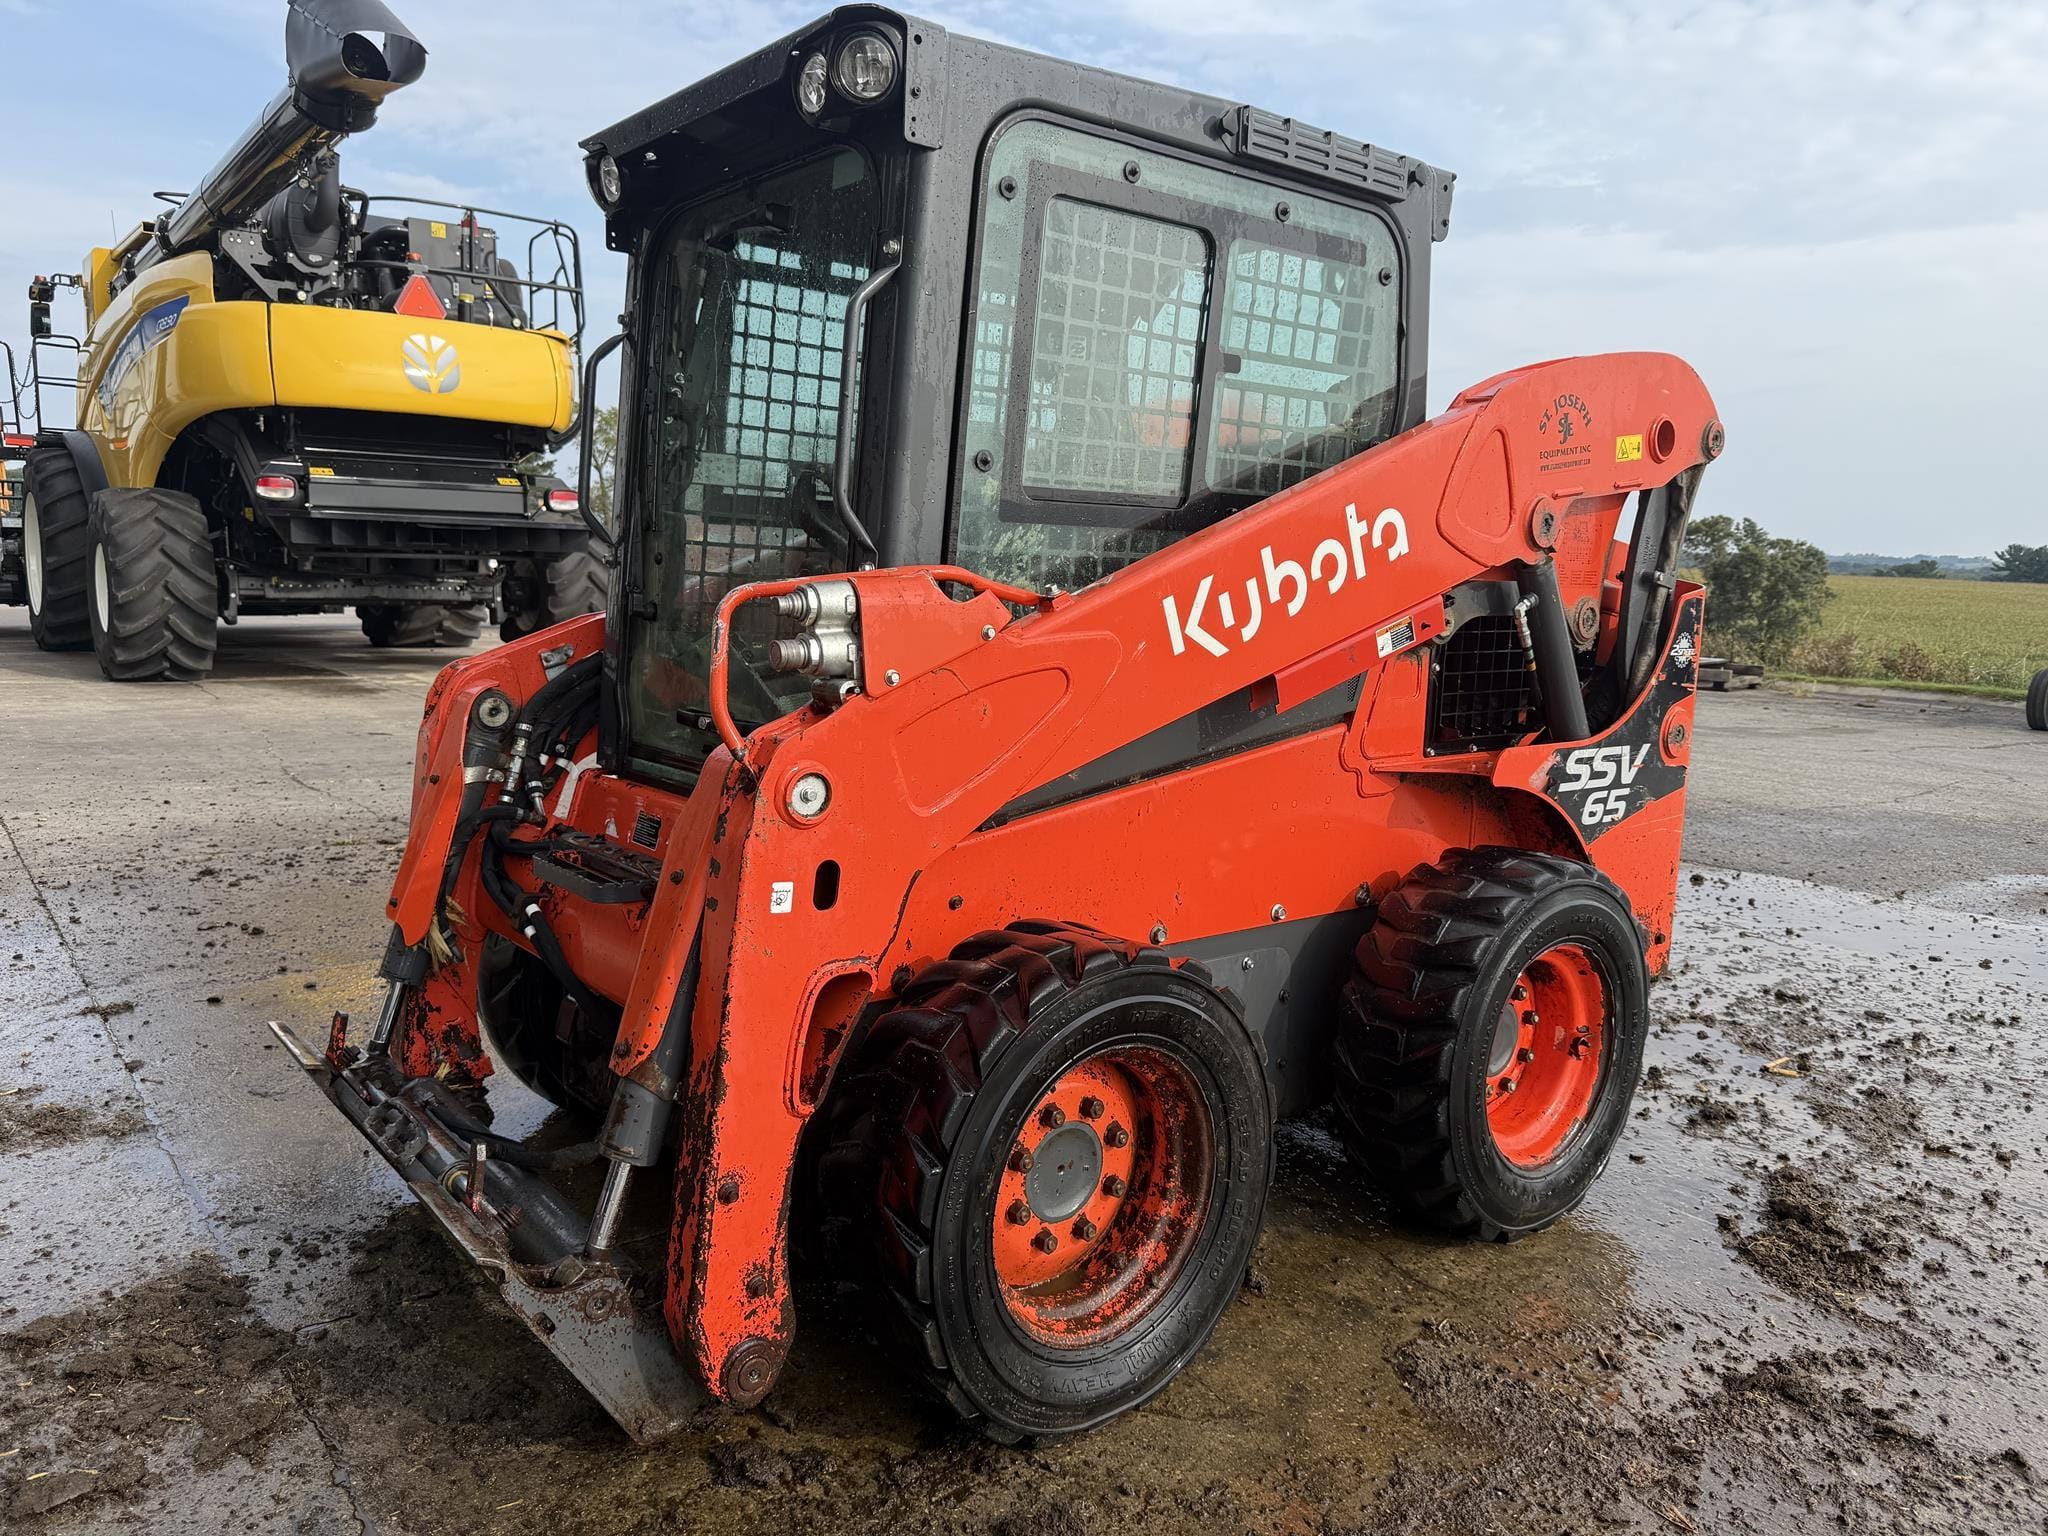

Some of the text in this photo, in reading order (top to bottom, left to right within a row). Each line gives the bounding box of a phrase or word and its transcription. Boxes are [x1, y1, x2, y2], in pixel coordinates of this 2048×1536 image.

[1539, 393, 1593, 434] ST. JOSEPH
[1539, 444, 1592, 460] EQUIPMENT INC
[1162, 502, 1409, 658] Kubota
[1558, 743, 1651, 792] SSV
[1581, 787, 1630, 825] 65
